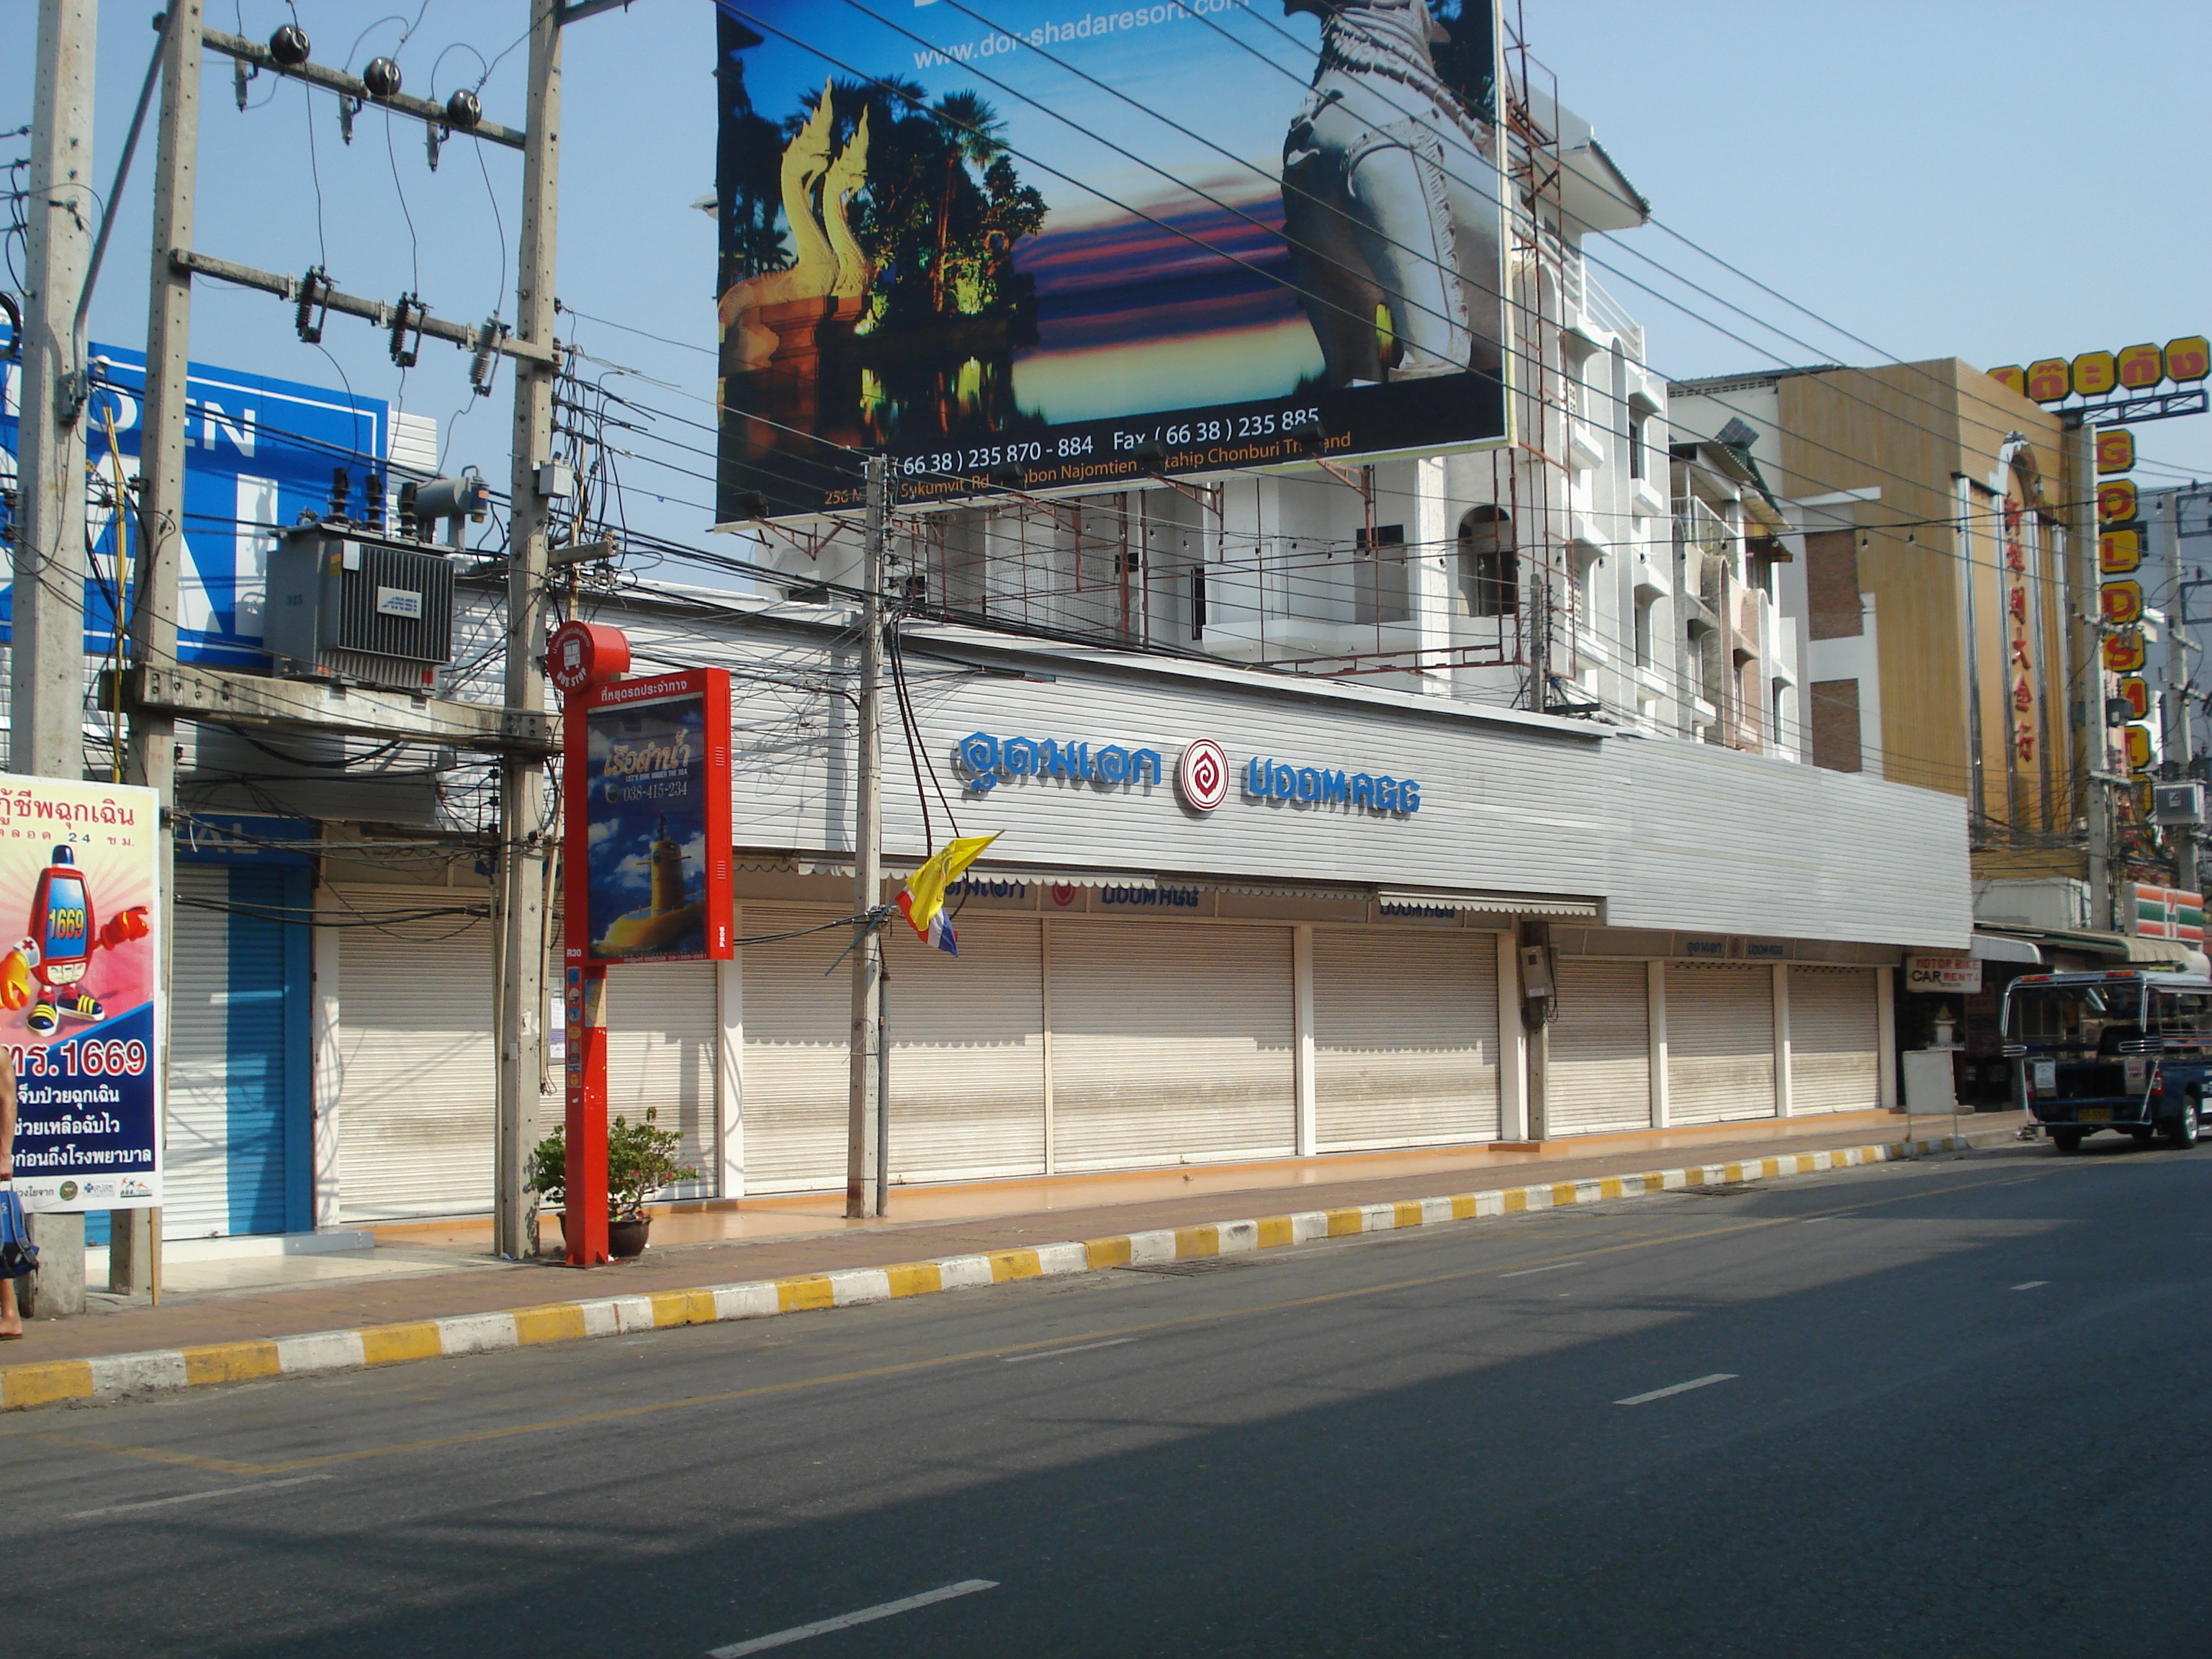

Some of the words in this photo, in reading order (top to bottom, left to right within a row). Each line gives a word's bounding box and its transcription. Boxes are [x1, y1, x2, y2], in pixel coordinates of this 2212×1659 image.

[904, 457, 925, 476] 66
[931, 452, 953, 472] 38
[968, 446, 1001, 469] 235
[1007, 441, 1041, 464] 870
[1058, 435, 1093, 457] 884
[1166, 424, 1189, 445] 66
[1196, 421, 1220, 442] 38
[1238, 414, 1275, 438] 235
[1208, 444, 1280, 464] Chonburi
[557, 671, 570, 688] BUS
[571, 667, 587, 687] STOP
[623, 781, 688, 801] 038-415-234
[68, 832, 91, 844] 24
[49, 907, 86, 940] 1669
[566, 948, 581, 958] R30
[1955, 958, 1979, 969] BIKE
[1912, 970, 1942, 984] CAR
[11, 1143, 152, 1168] ก่อนถึงโรงพยาบาล
